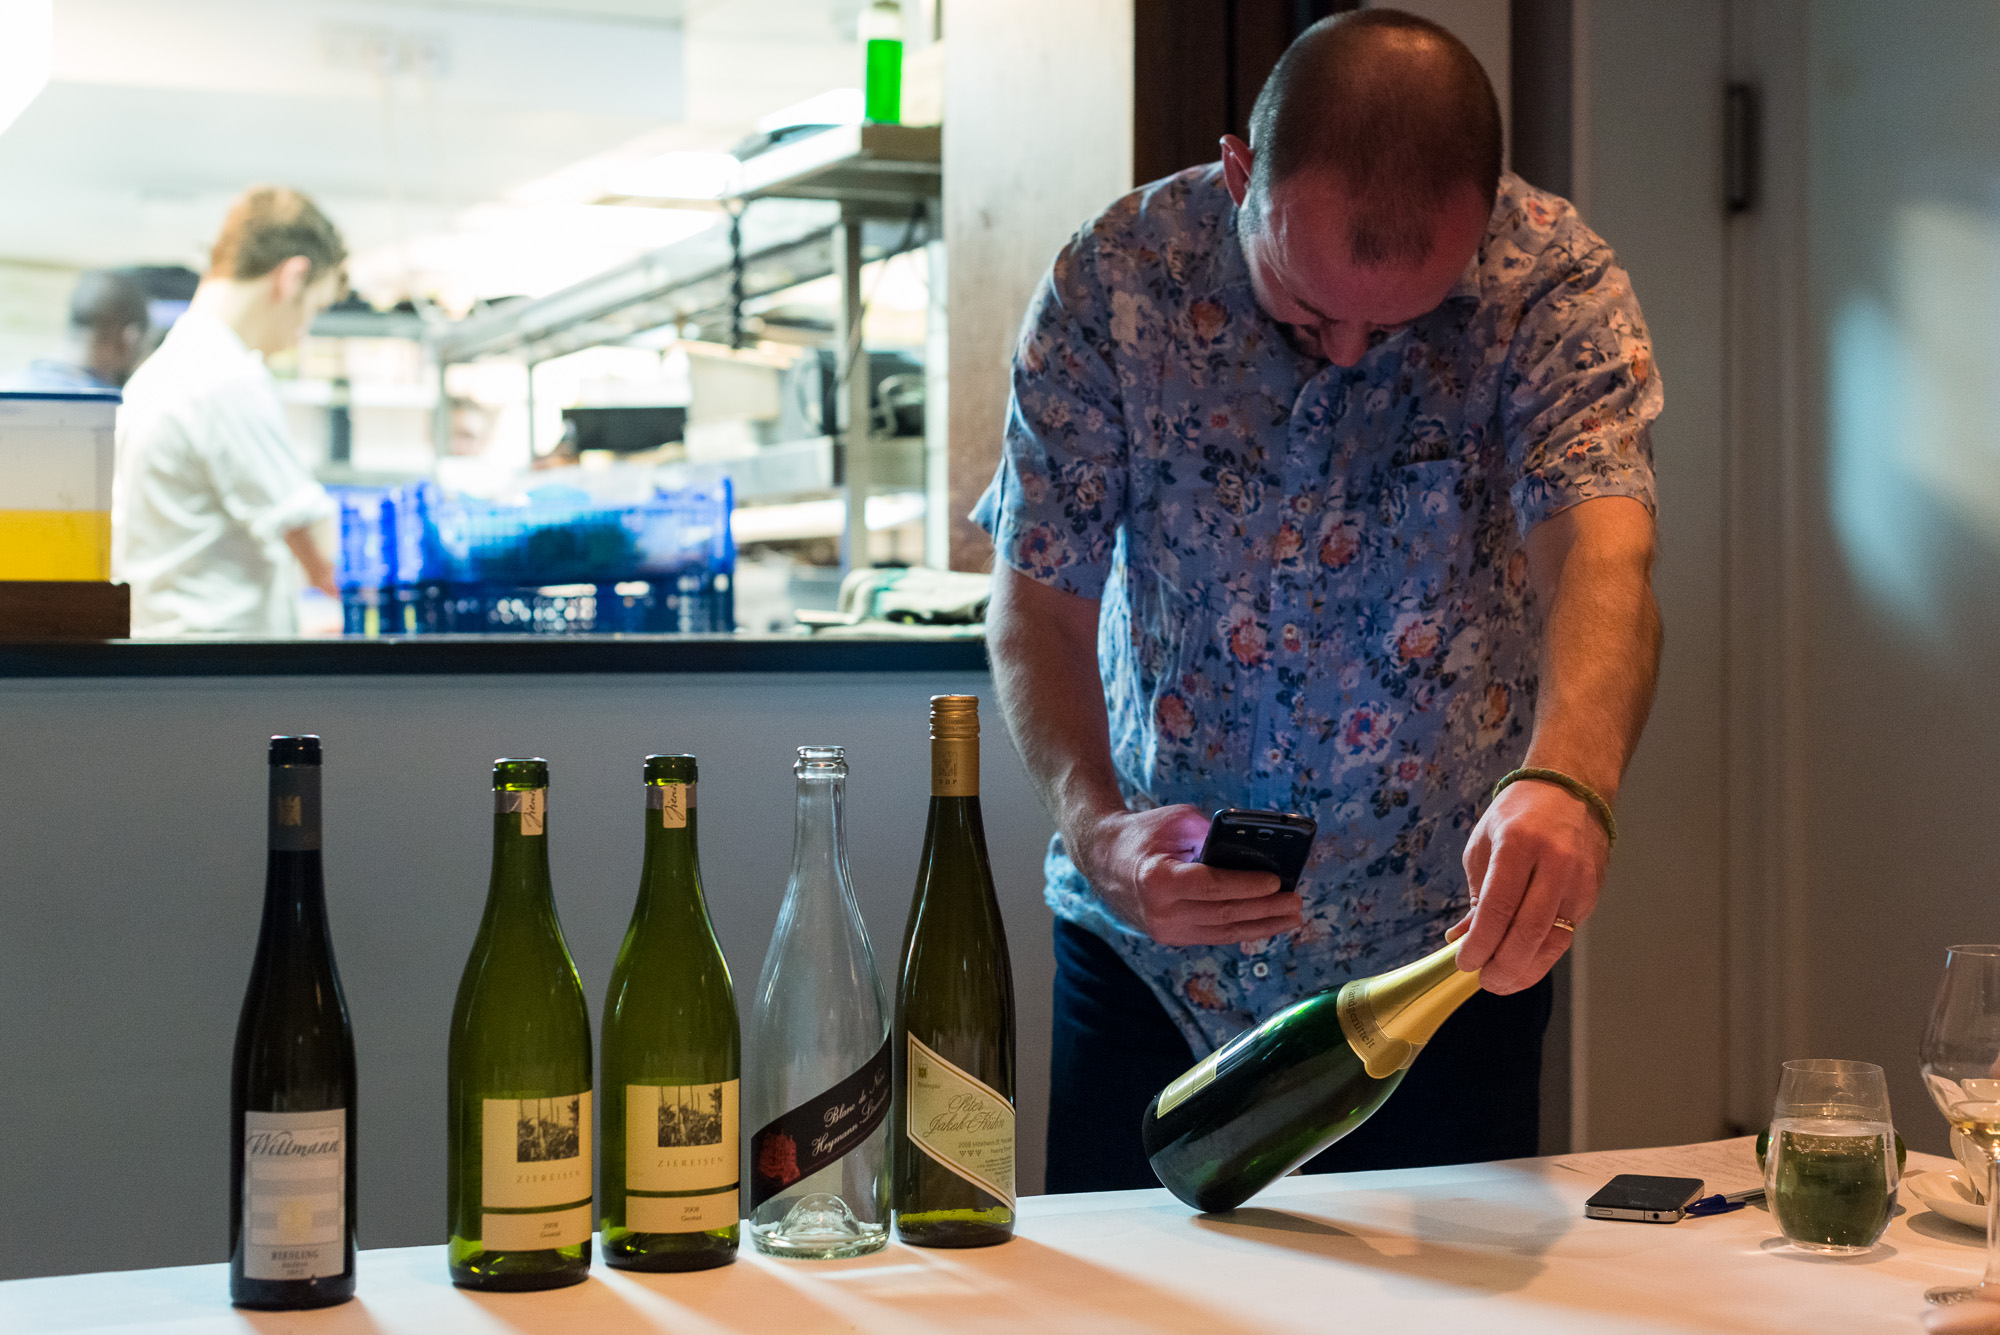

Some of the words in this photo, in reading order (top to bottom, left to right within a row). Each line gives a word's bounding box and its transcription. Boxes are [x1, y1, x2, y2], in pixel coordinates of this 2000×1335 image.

[948, 1092, 984, 1114] Peter
[824, 1103, 856, 1128] Blanc
[922, 1112, 970, 1138] Jakob
[246, 1130, 339, 1156] Wittmann
[657, 1156, 723, 1168] ZIEREISEN
[516, 1170, 580, 1184] ZIEREISEN
